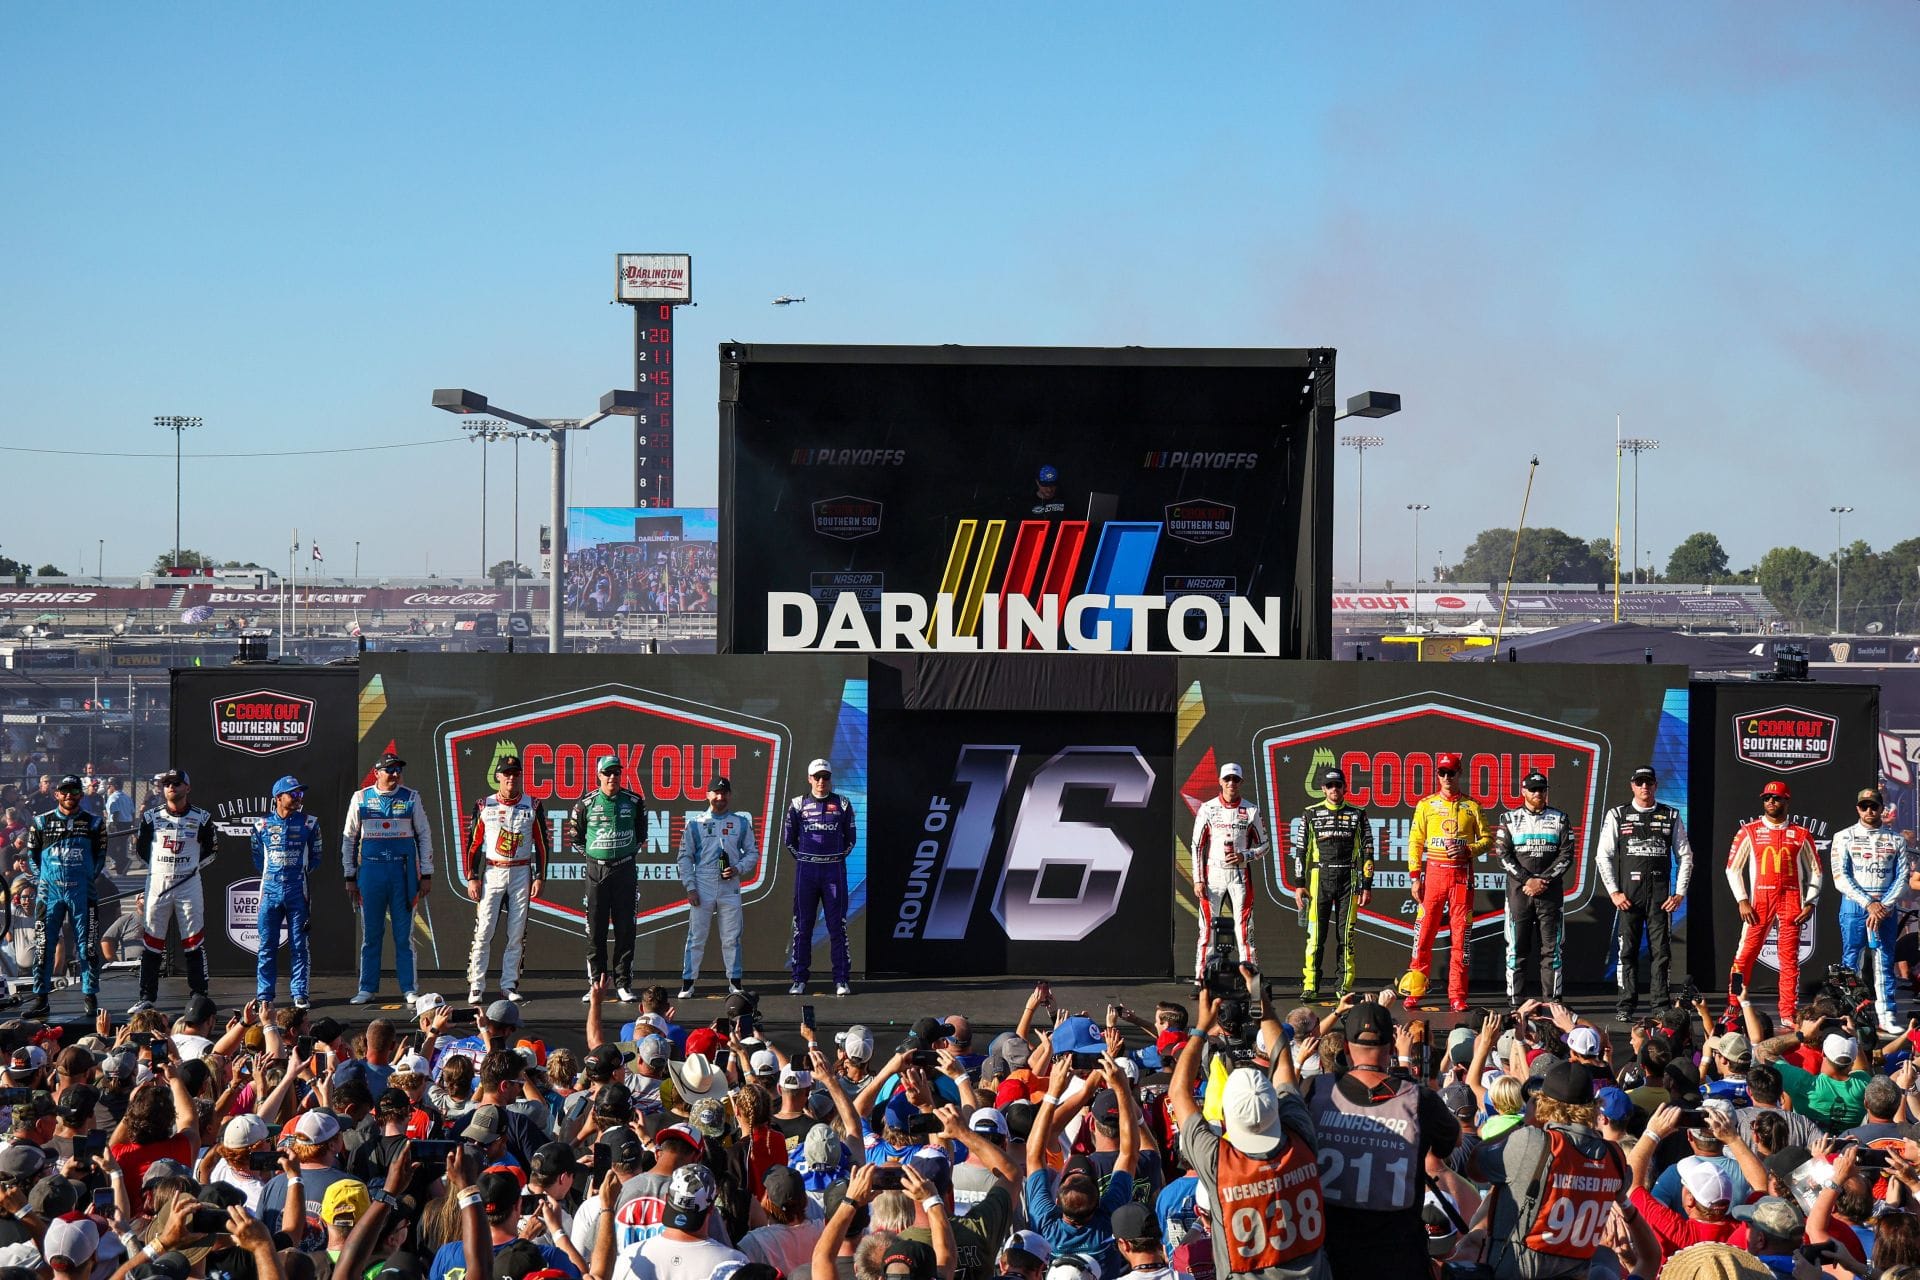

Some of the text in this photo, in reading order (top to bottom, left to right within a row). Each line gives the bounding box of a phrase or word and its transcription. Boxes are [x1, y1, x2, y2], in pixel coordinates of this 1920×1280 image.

[627, 266, 683, 278] DARLINGTON
[660, 305, 669, 320] 0
[640, 328, 669, 343] 1 20
[640, 350, 669, 364] 2 11
[640, 371, 669, 385] 3 45
[655, 392, 669, 406] 12
[640, 415, 647, 424] 5
[640, 436, 646, 445] 6
[640, 457, 646, 466] 7
[816, 449, 905, 466] PLAYOFFS
[1170, 452, 1258, 468] PLAYOFFS
[640, 478, 647, 487] 8
[817, 517, 877, 526] SOUTHERN 500
[1171, 521, 1230, 530] SOUTHERN 500
[834, 574, 872, 584] NASCAR
[1187, 578, 1225, 588] NASCAR
[0, 592, 97, 603] SERIES
[207, 593, 367, 604] BUSCH LIGHT
[403, 592, 502, 605] Coca-Cola
[1357, 597, 1409, 609] OUT
[767, 592, 1281, 657] DARLINGTON
[1829, 642, 1850, 663] 10
[236, 704, 300, 720] COOK OUT
[221, 721, 305, 733] SOUTHERN 500
[1758, 720, 1823, 737] COOK OUT
[1743, 738, 1828, 752] SOUTHERN 500
[803, 823, 838, 833] yahoo!
[922, 744, 1156, 941] 16
[157, 855, 191, 863] LIBERTY
[892, 795, 951, 939] ROUND OF
[234, 897, 259, 905] LABO
[1340, 1112, 1407, 1136] NASCAR
[1317, 1132, 1406, 1150] PRODUCTIONS
[1222, 1162, 1318, 1203] LICENSED PHOTO
[1317, 1147, 1408, 1207] 211
[1552, 1173, 1622, 1193] LICENSED PHO
[625, 1200, 658, 1224] KYL
[1231, 1188, 1322, 1258] 938
